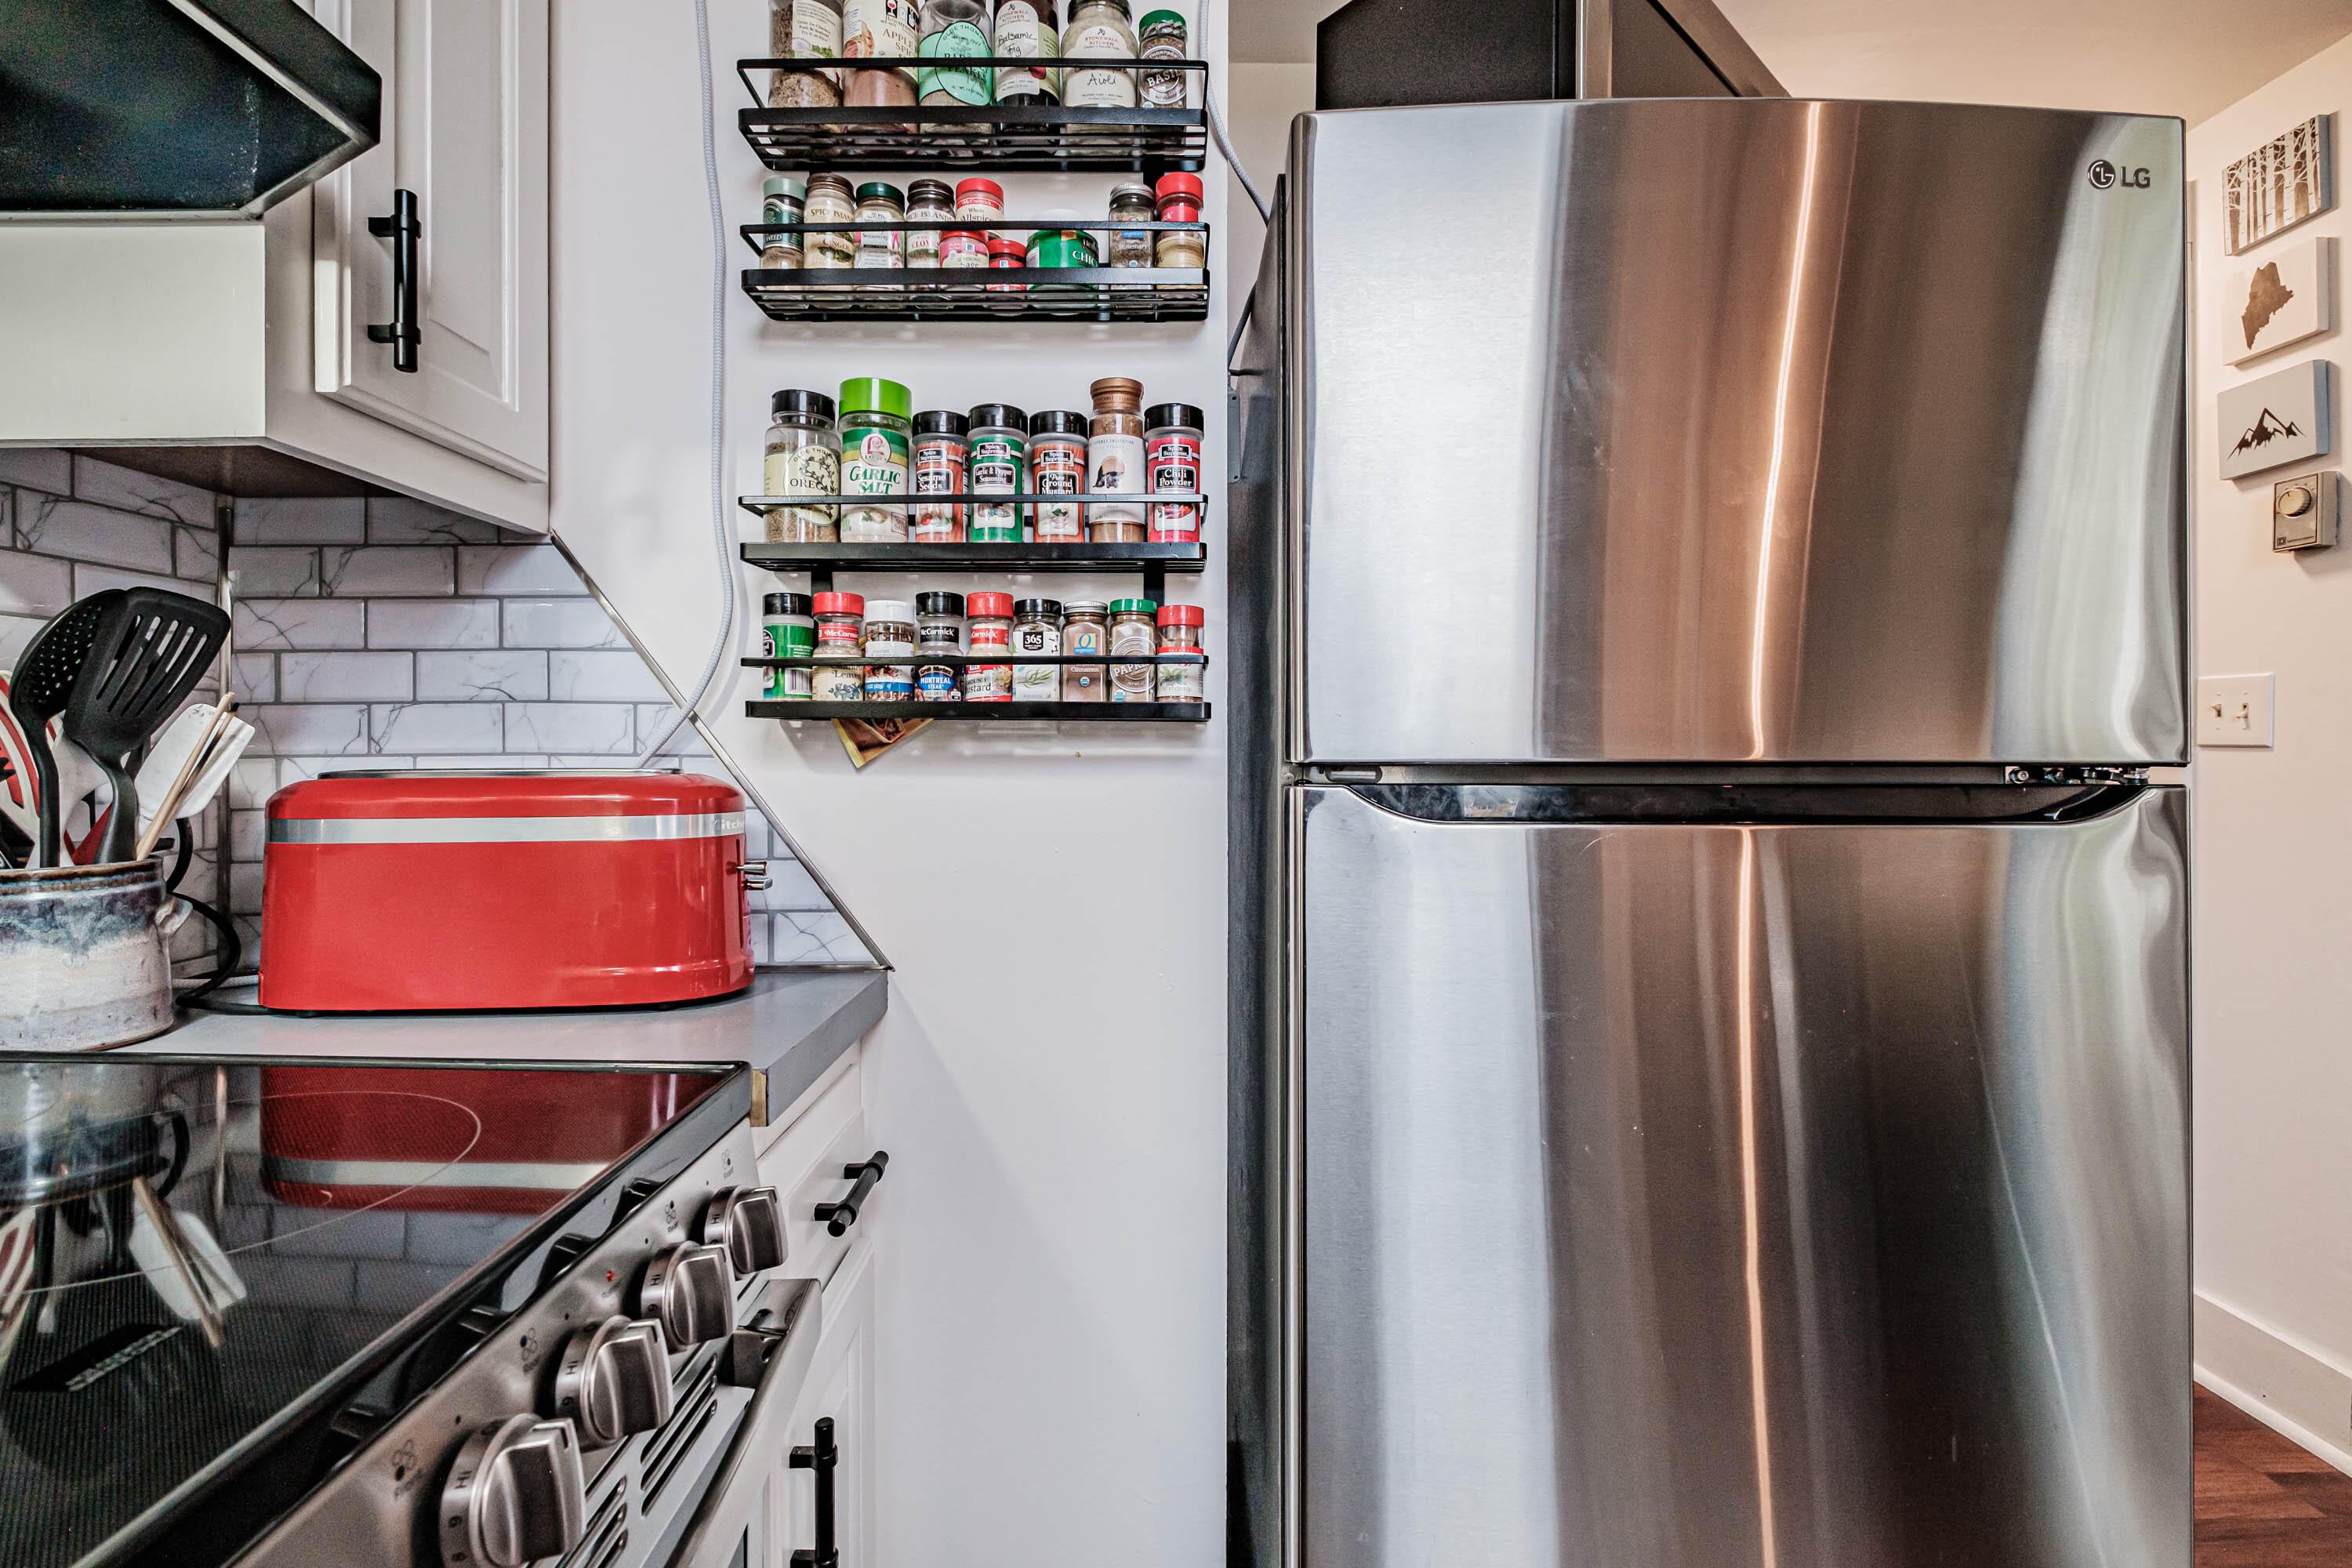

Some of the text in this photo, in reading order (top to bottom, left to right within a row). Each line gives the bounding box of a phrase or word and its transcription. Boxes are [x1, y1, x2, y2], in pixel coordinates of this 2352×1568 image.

[997, 31, 1037, 48] Balsamic
[1087, 73, 1116, 86] Aioli
[2120, 165, 2151, 189] LG
[920, 211, 952, 220] ISANDS
[912, 239, 939, 249] CLOVS
[850, 466, 901, 484] GARLIC
[1164, 468, 1187, 478] Chili
[917, 474, 946, 483] Sesame
[1042, 478, 1073, 487] Ground
[1160, 477, 1192, 487] Powder
[858, 481, 892, 495] SALT
[1041, 486, 1073, 495] Mustard
[1025, 634, 1042, 644] 365
[967, 683, 991, 693] ustard
[713, 818, 744, 830] Kitch
